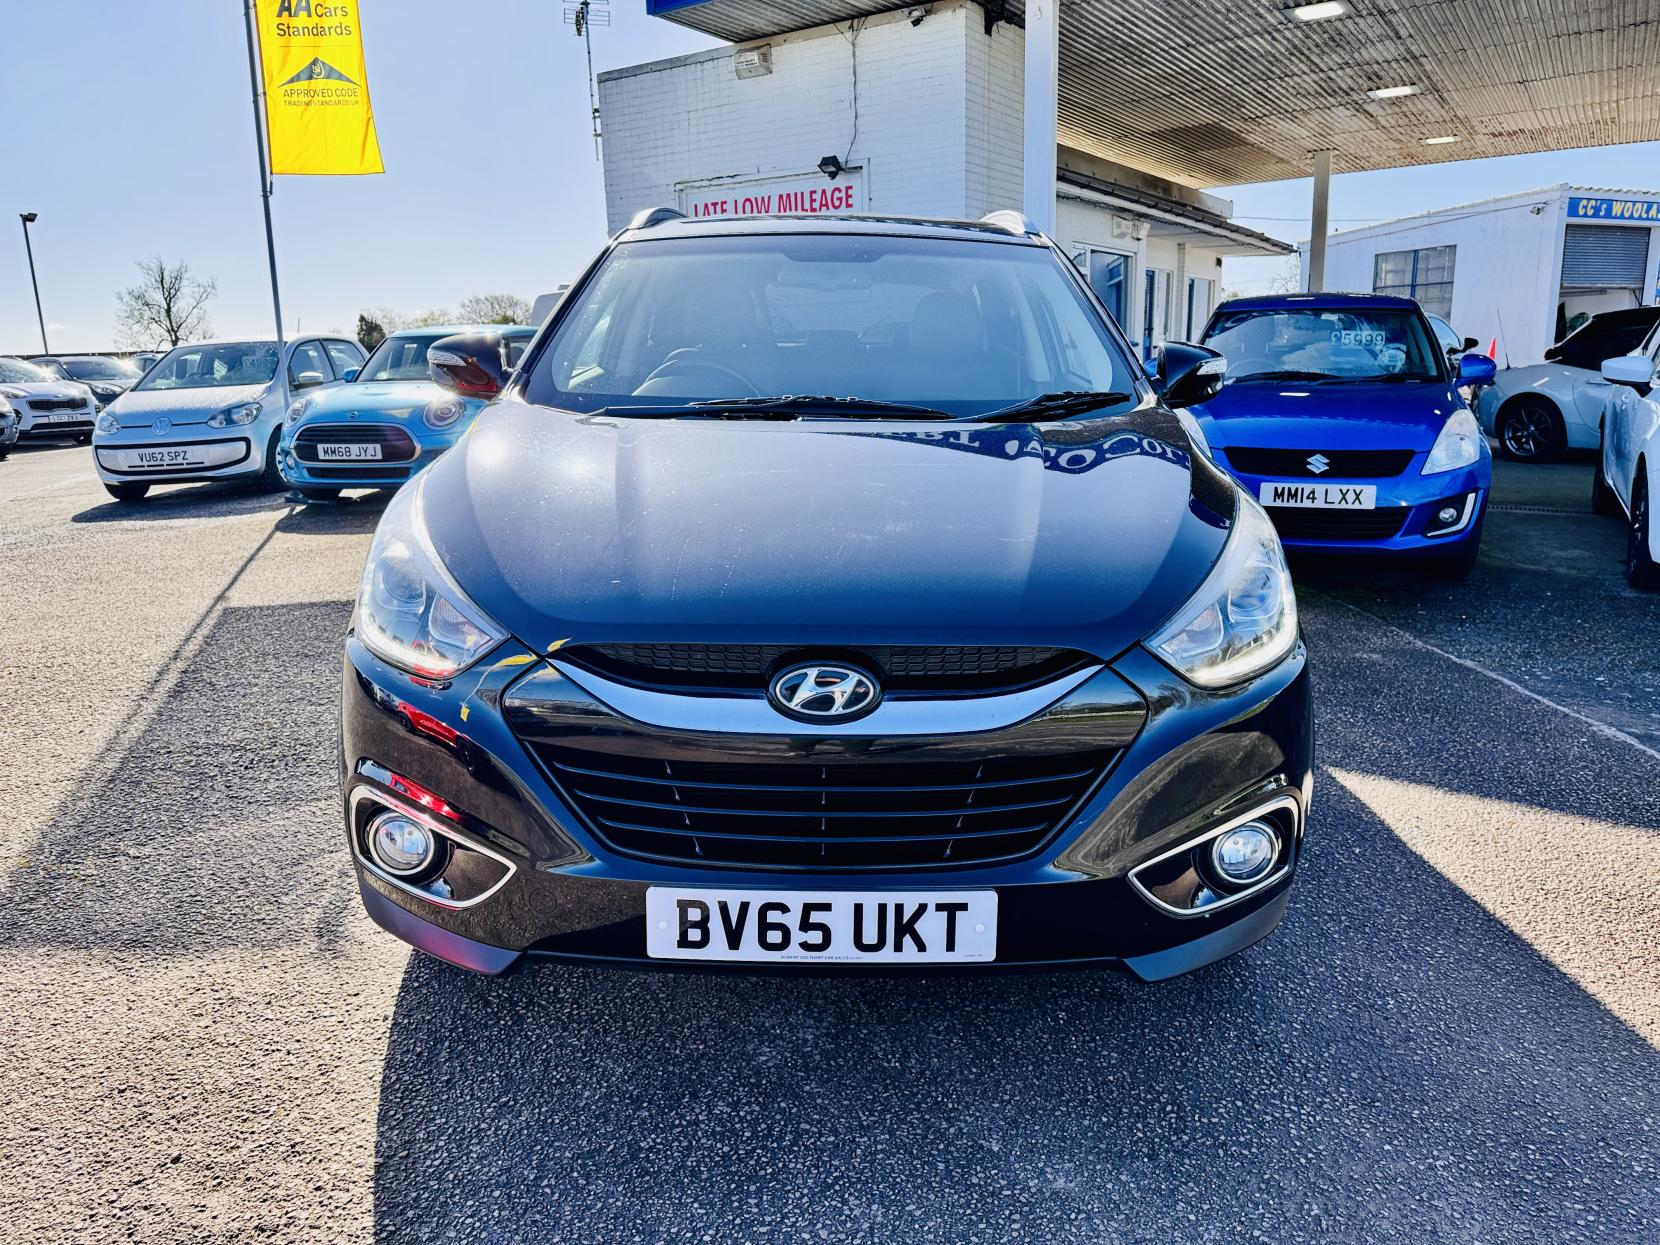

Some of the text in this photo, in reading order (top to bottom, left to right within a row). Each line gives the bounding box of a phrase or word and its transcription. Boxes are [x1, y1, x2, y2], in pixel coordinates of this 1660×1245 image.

[276, 0, 348, 18] AA Cars
[276, 22, 352, 37] Standards
[283, 87, 358, 98] APPROVED CODE
[777, 185, 854, 214] MILEAGE
[1611, 200, 1660, 219] WOOLA
[138, 450, 188, 462] VU62 SPZ
[322, 446, 377, 458] MM68 JYJ
[1273, 486, 1363, 505] MM14 LXX
[676, 899, 969, 953] BV65 UKT
